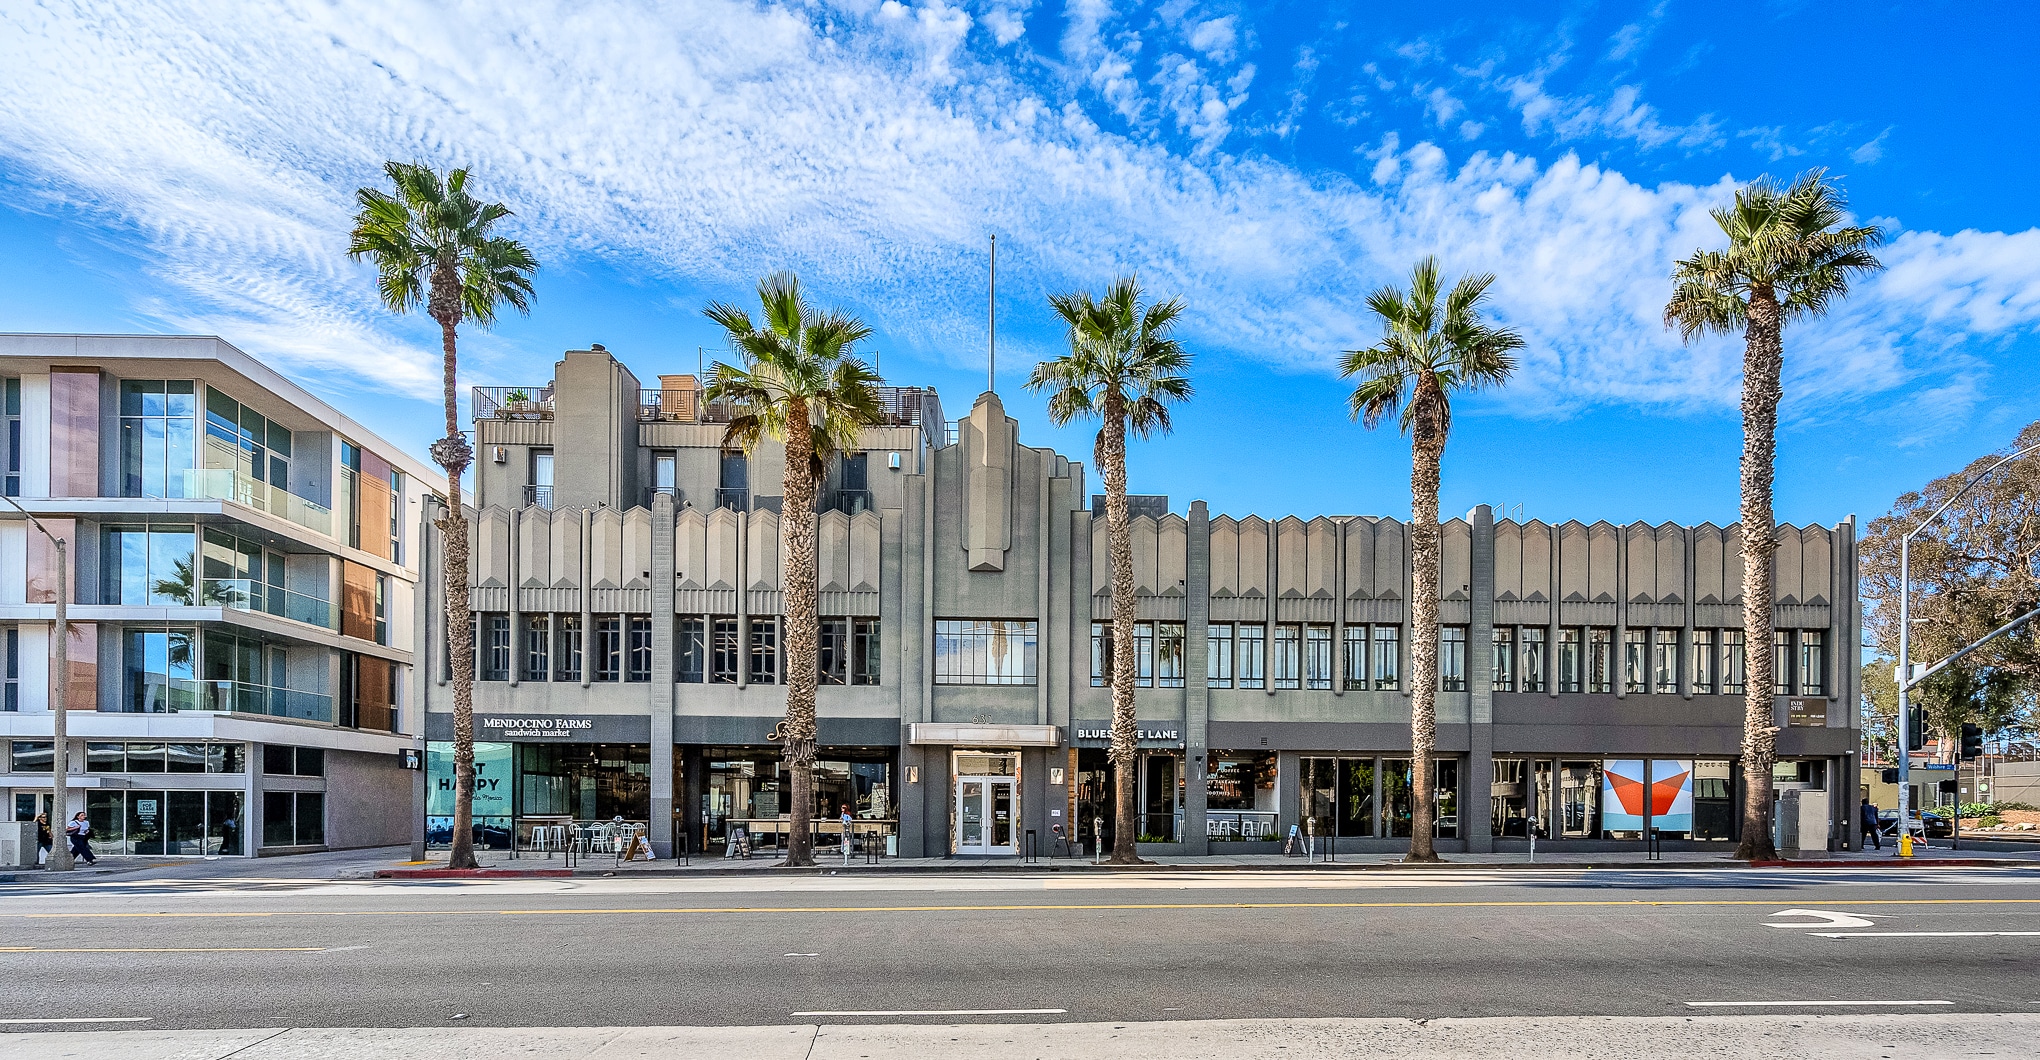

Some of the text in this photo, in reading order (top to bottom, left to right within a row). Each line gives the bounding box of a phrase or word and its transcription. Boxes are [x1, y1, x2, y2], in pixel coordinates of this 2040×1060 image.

[483, 718, 592, 729] MENDOCINO FARMS
[504, 729, 570, 737] sandwich market
[1148, 730, 1178, 739] LANE
